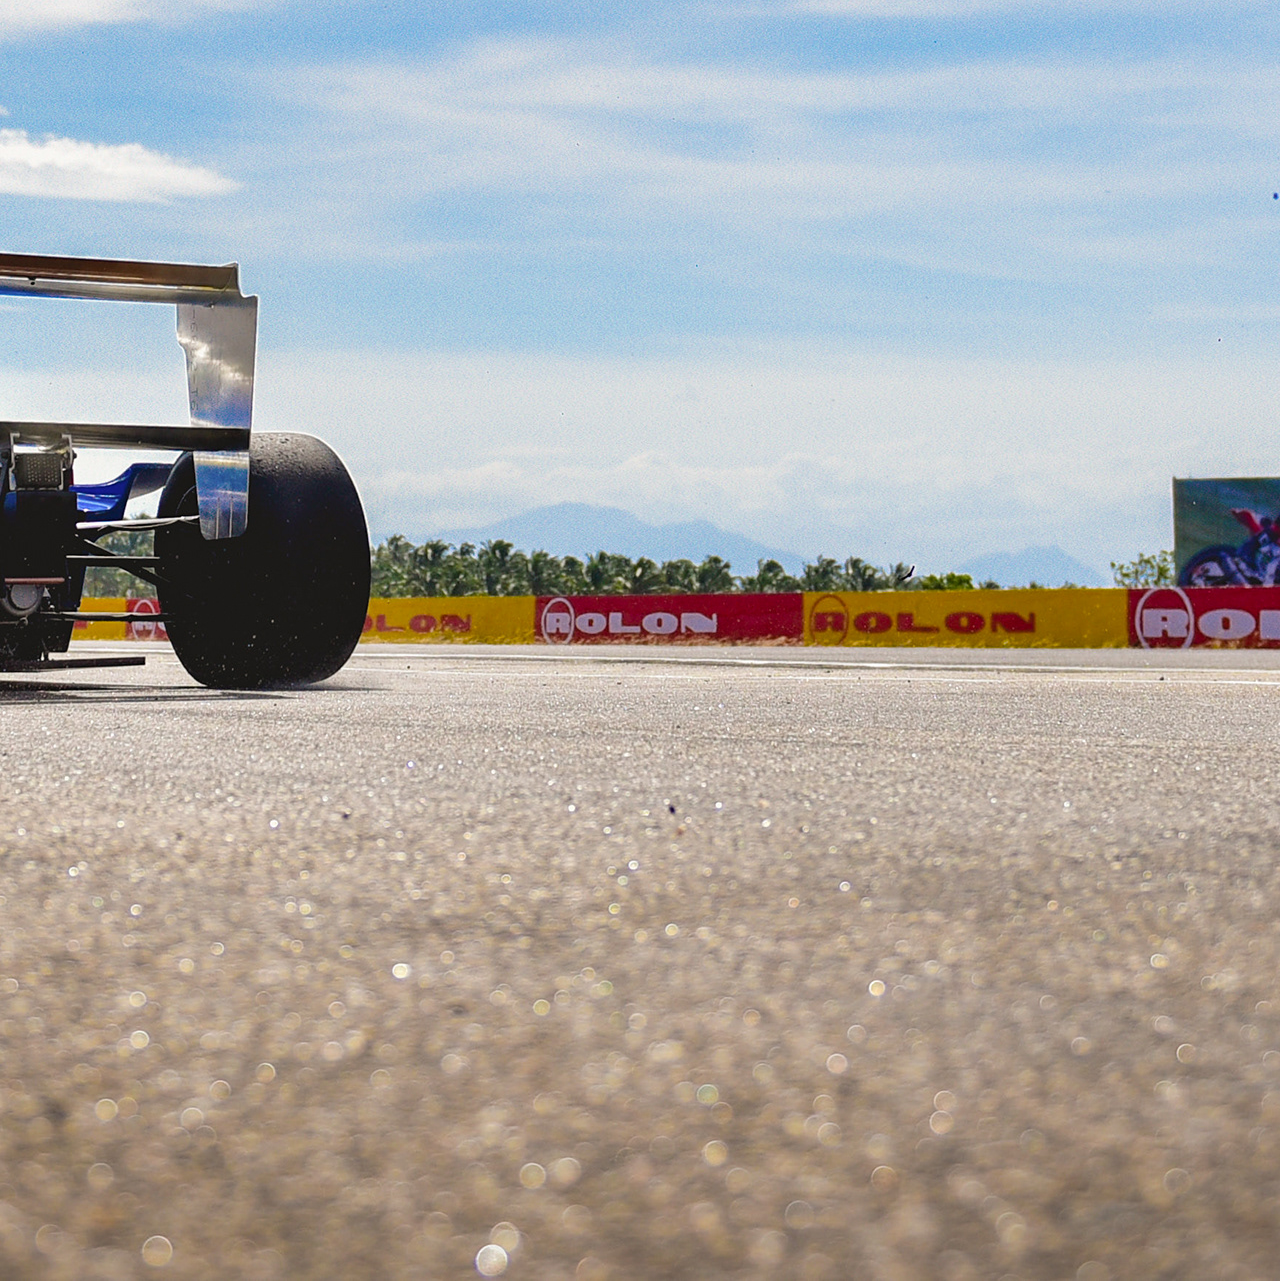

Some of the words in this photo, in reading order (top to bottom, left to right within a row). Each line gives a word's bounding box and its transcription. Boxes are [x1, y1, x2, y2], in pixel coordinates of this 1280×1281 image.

[362, 613, 472, 634] LON
[546, 611, 718, 635] ROLON
[813, 610, 1036, 635] ROLON
